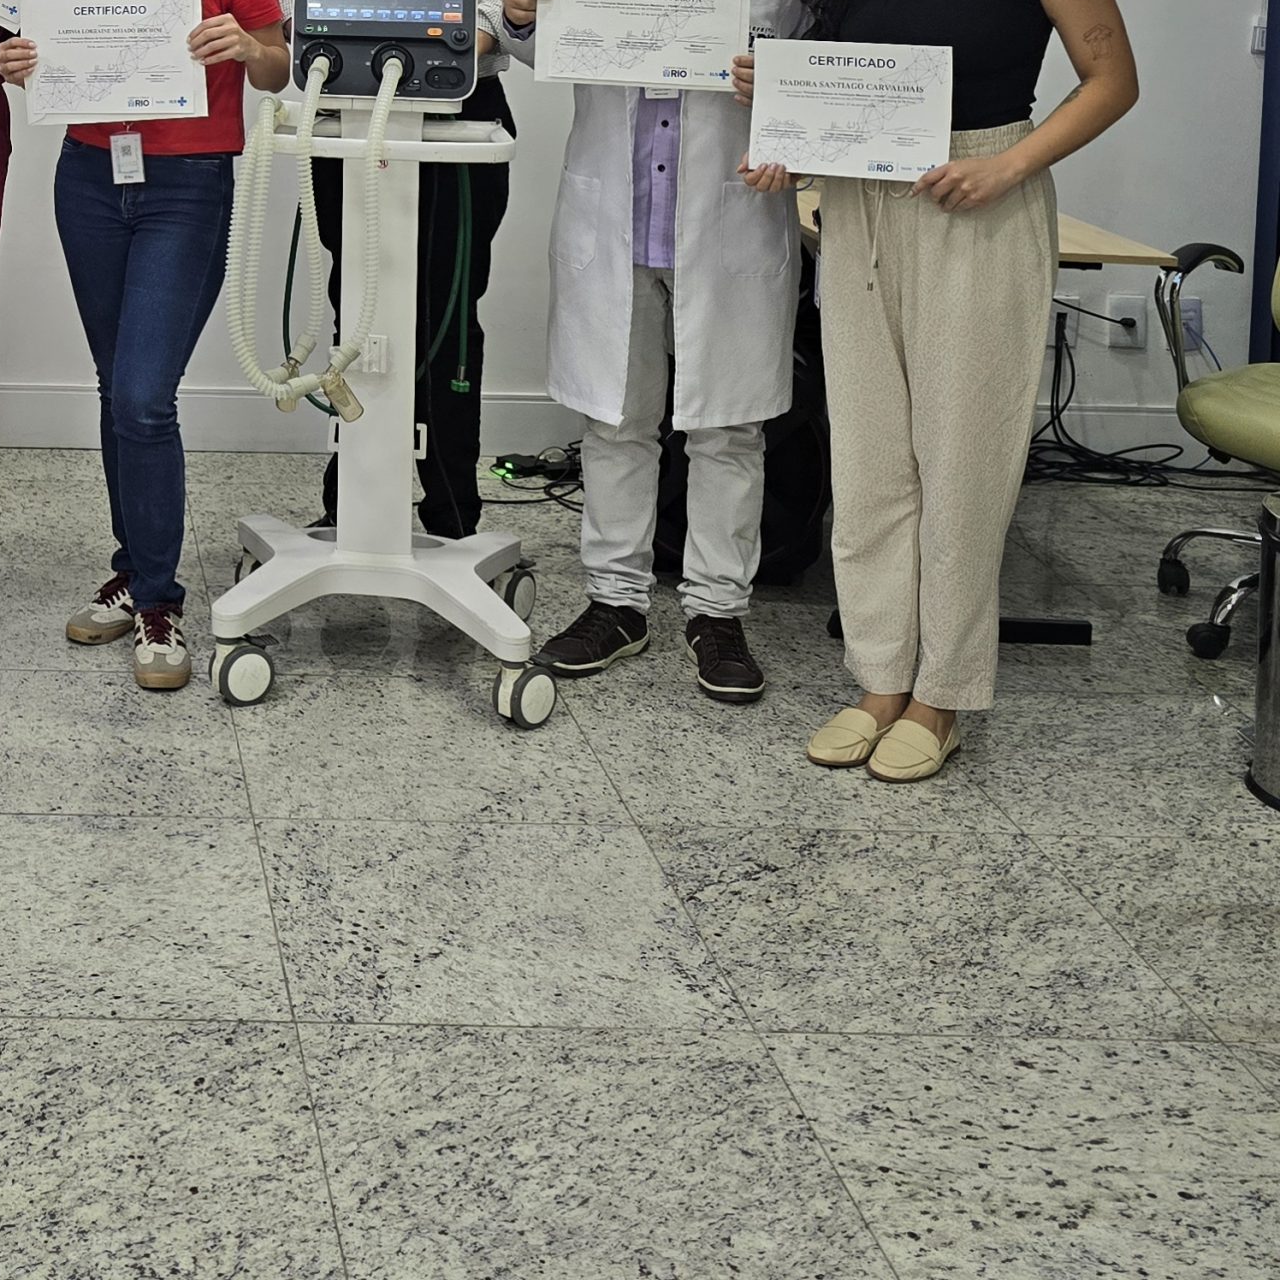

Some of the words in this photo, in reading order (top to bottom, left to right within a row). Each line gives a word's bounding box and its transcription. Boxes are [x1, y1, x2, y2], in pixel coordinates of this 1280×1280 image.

[73, 5, 147, 16] CERTIFICADO
[808, 55, 896, 69] CERTIFICADO
[671, 69, 687, 78] RIO
[780, 79, 818, 88] ISADORA
[819, 81, 864, 90] SANTIAGO
[135, 99, 150, 108] RIO
[876, 163, 894, 173] RIO
